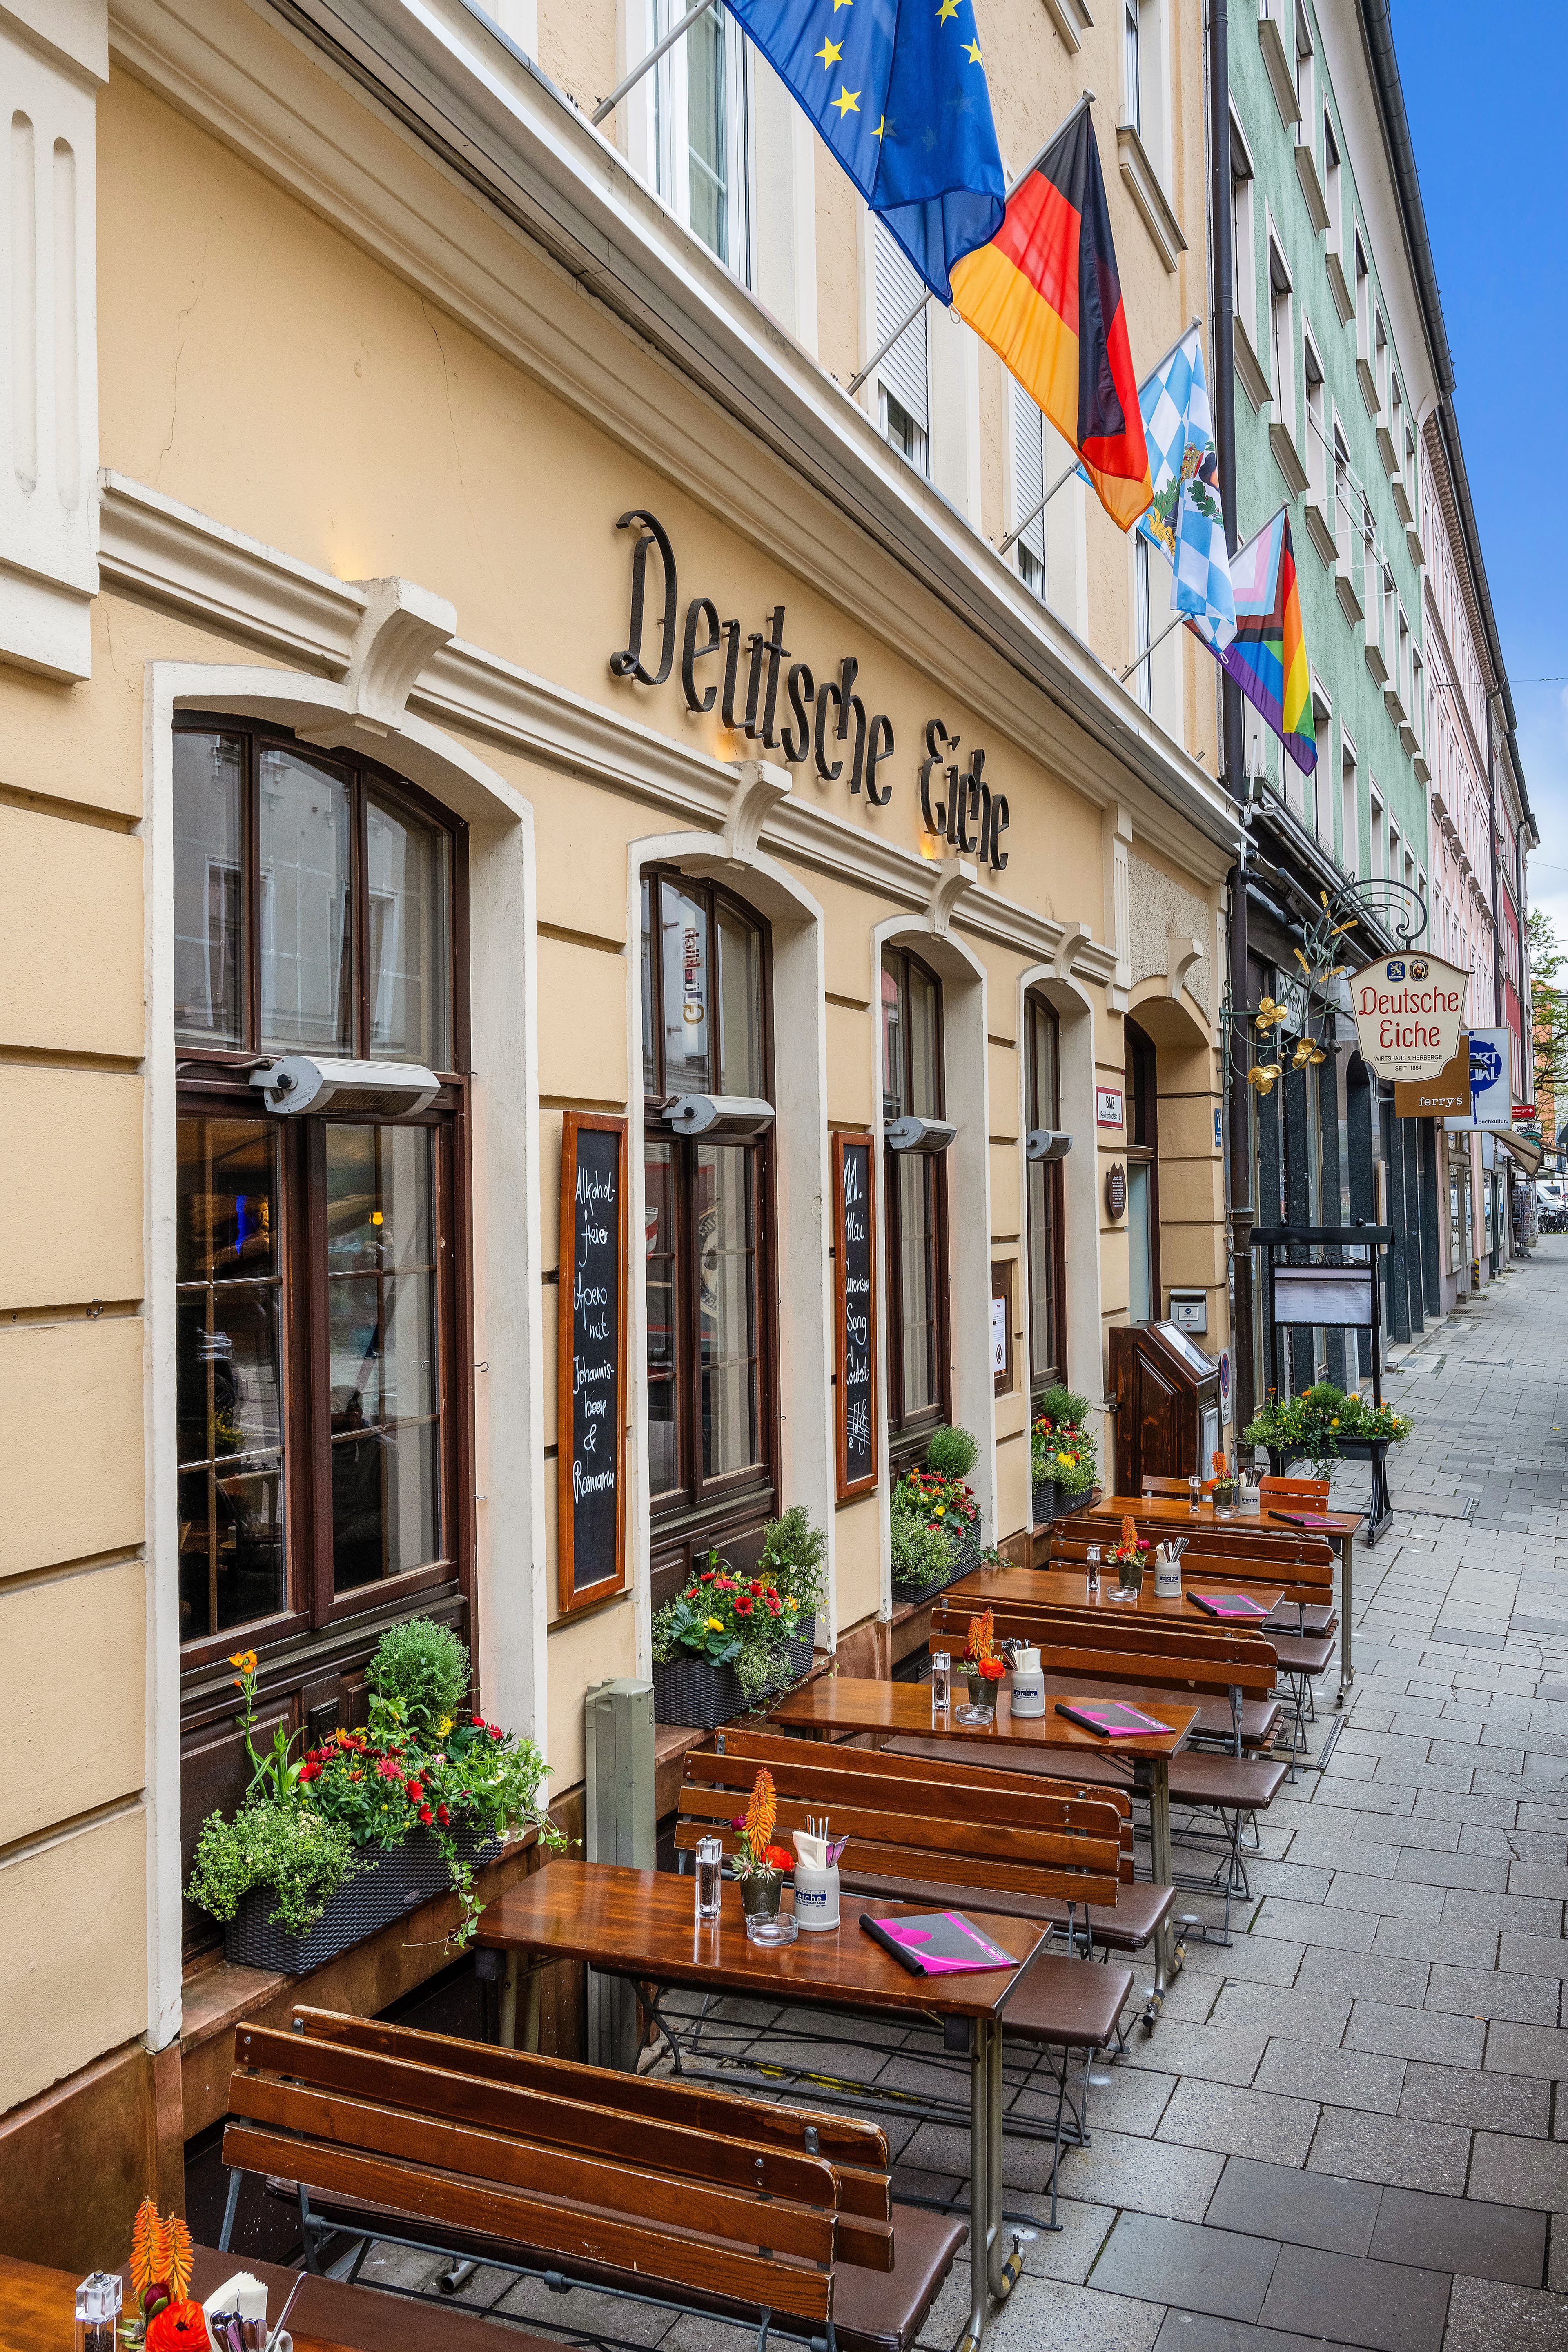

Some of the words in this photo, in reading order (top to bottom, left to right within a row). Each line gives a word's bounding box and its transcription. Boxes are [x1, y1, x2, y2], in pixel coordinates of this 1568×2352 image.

[610, 510, 894, 806] Deutsche
[921, 719, 1009, 871] Eiche
[1359, 986, 1459, 1016] Deutsche
[1380, 1020, 1440, 1048] Eiche
[1106, 1096, 1115, 1109] BMZ
[1217, 1112, 1221, 1128] 13
[575, 1166, 615, 1216] Alkohol-
[579, 1209, 608, 1267] freier
[845, 1212, 865, 1242] Mai
[590, 1312, 610, 1340] mit
[847, 1303, 866, 1345] Song
[584, 1424, 597, 1453] &
[573, 1456, 615, 1504] Rosmarin
[798, 1893, 822, 1902] eiche
